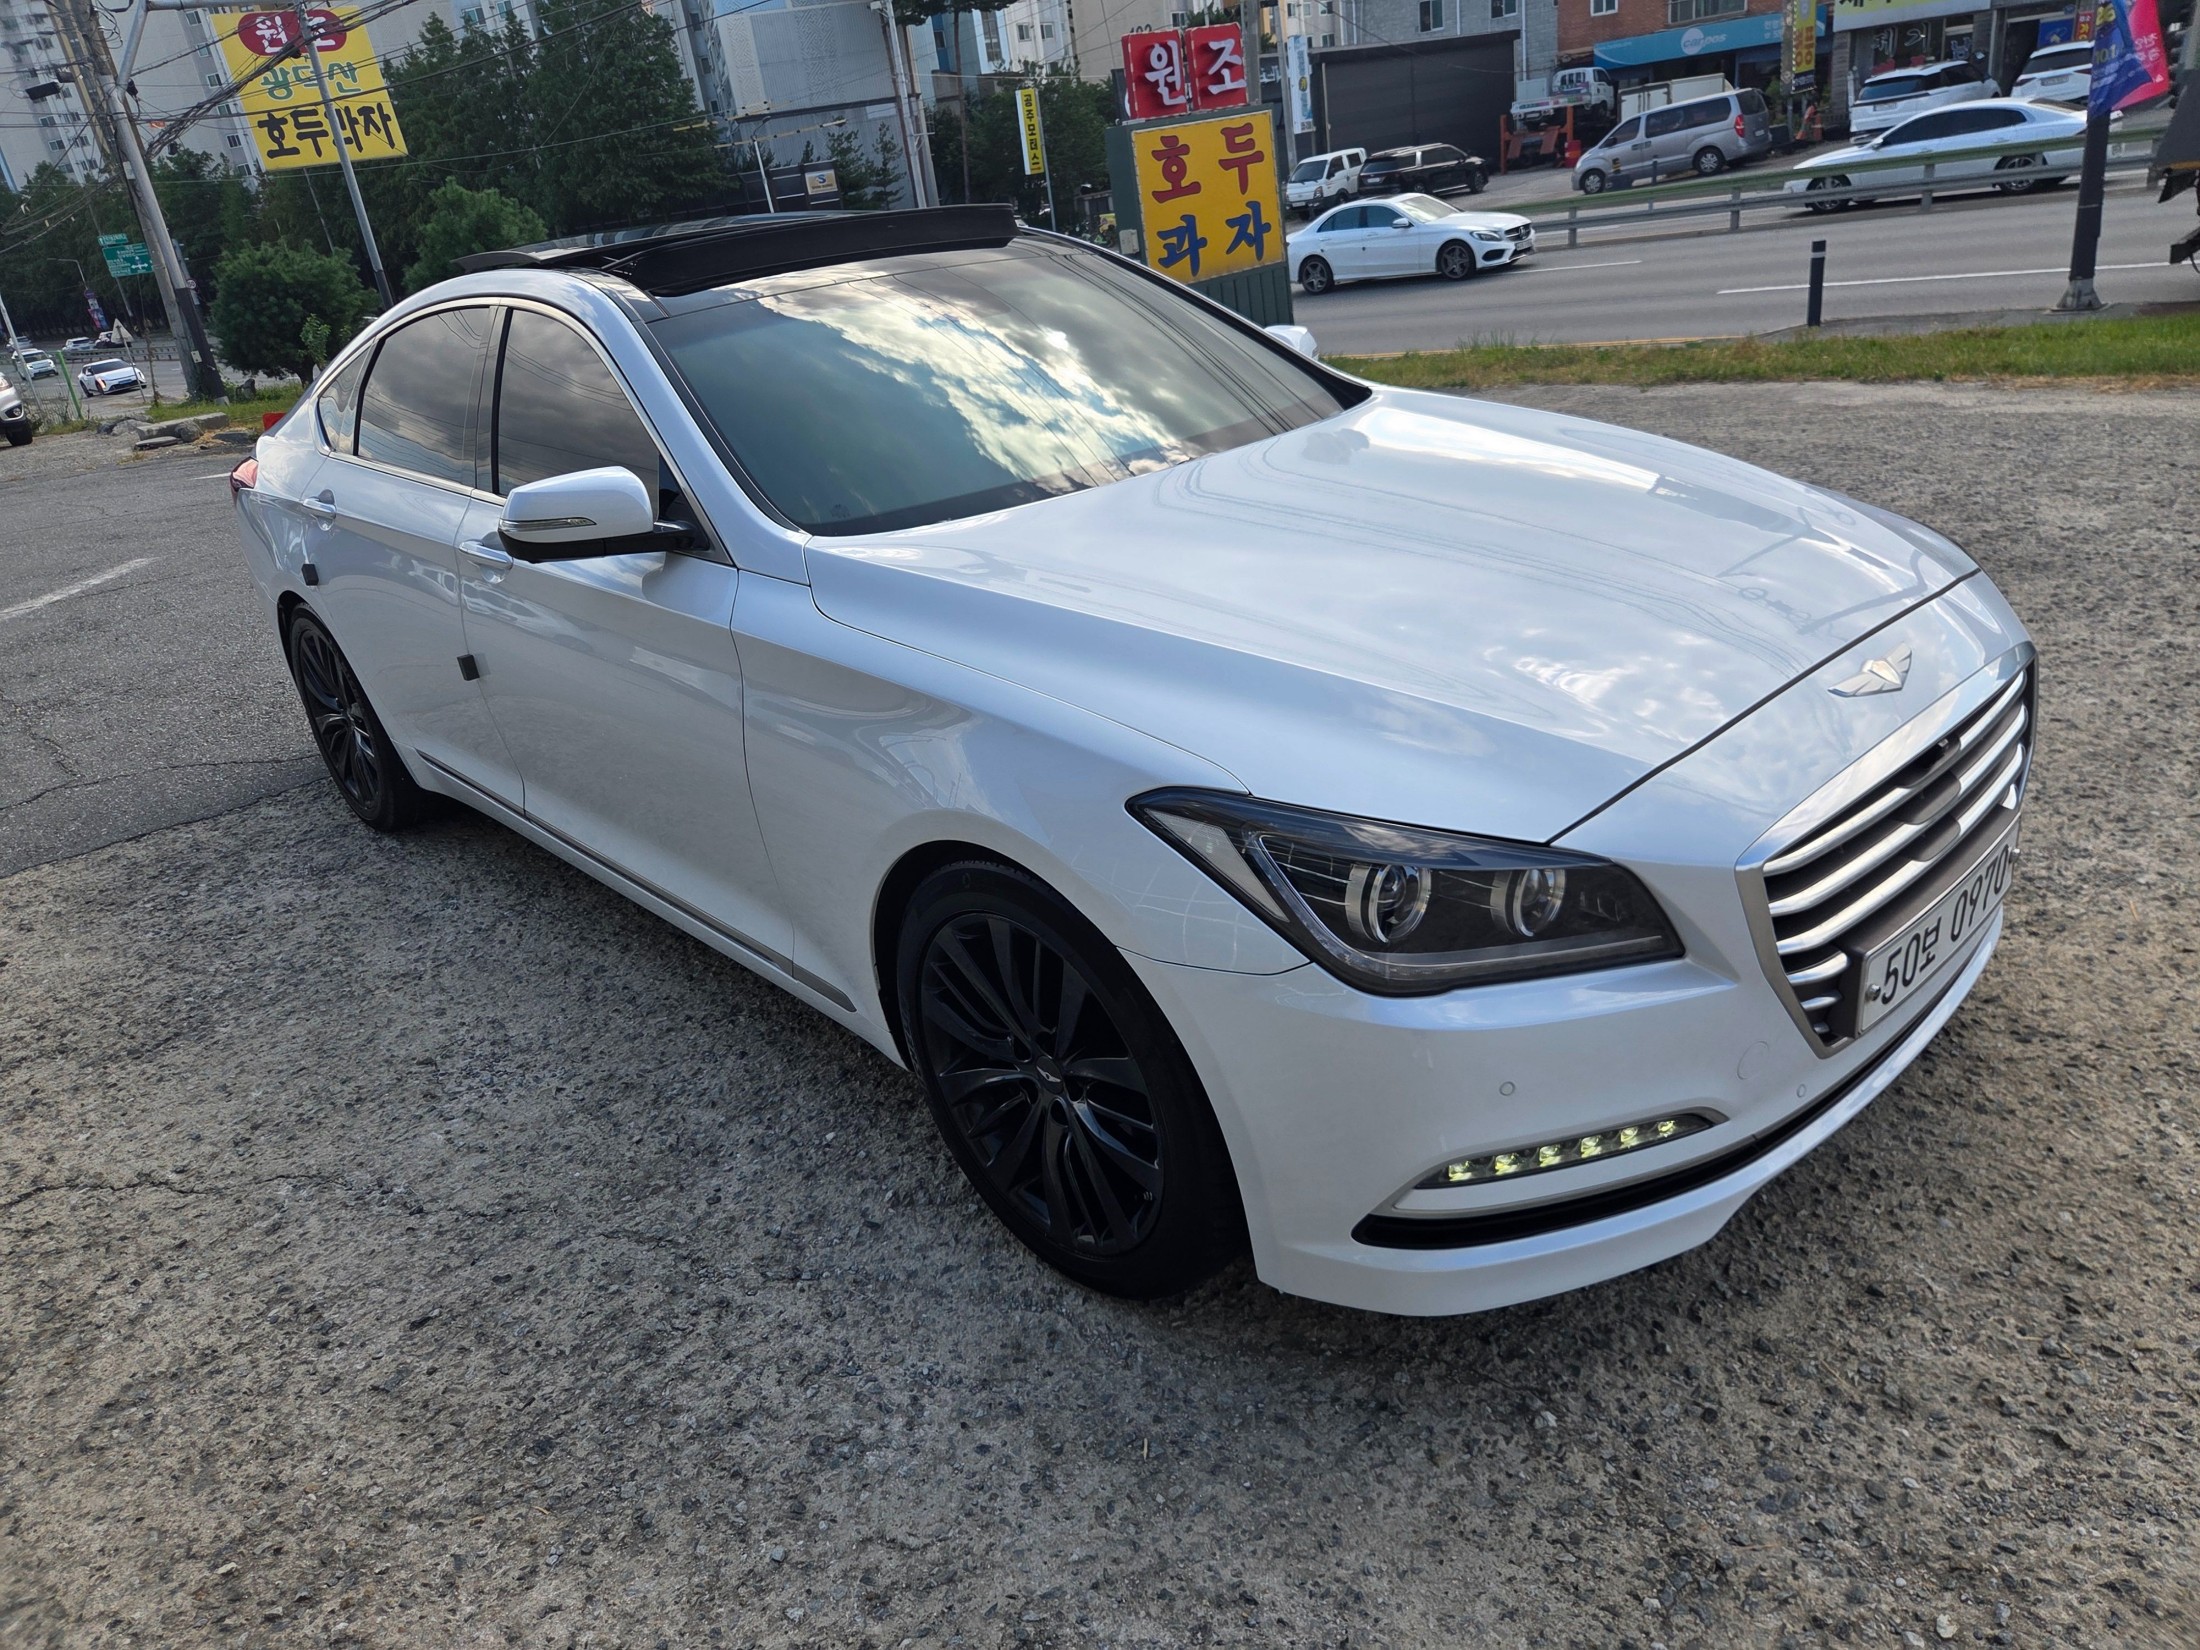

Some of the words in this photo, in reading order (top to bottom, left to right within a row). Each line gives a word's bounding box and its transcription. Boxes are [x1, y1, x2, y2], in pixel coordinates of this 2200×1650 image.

[1145, 39, 1247, 106] 원조
[1024, 93, 1041, 166] 공주모터스
[1151, 123, 1264, 204] 호두
[1157, 201, 1271, 277] 과자
[1881, 917, 1941, 1005] 50보
[1951, 844, 2009, 942] 0970
